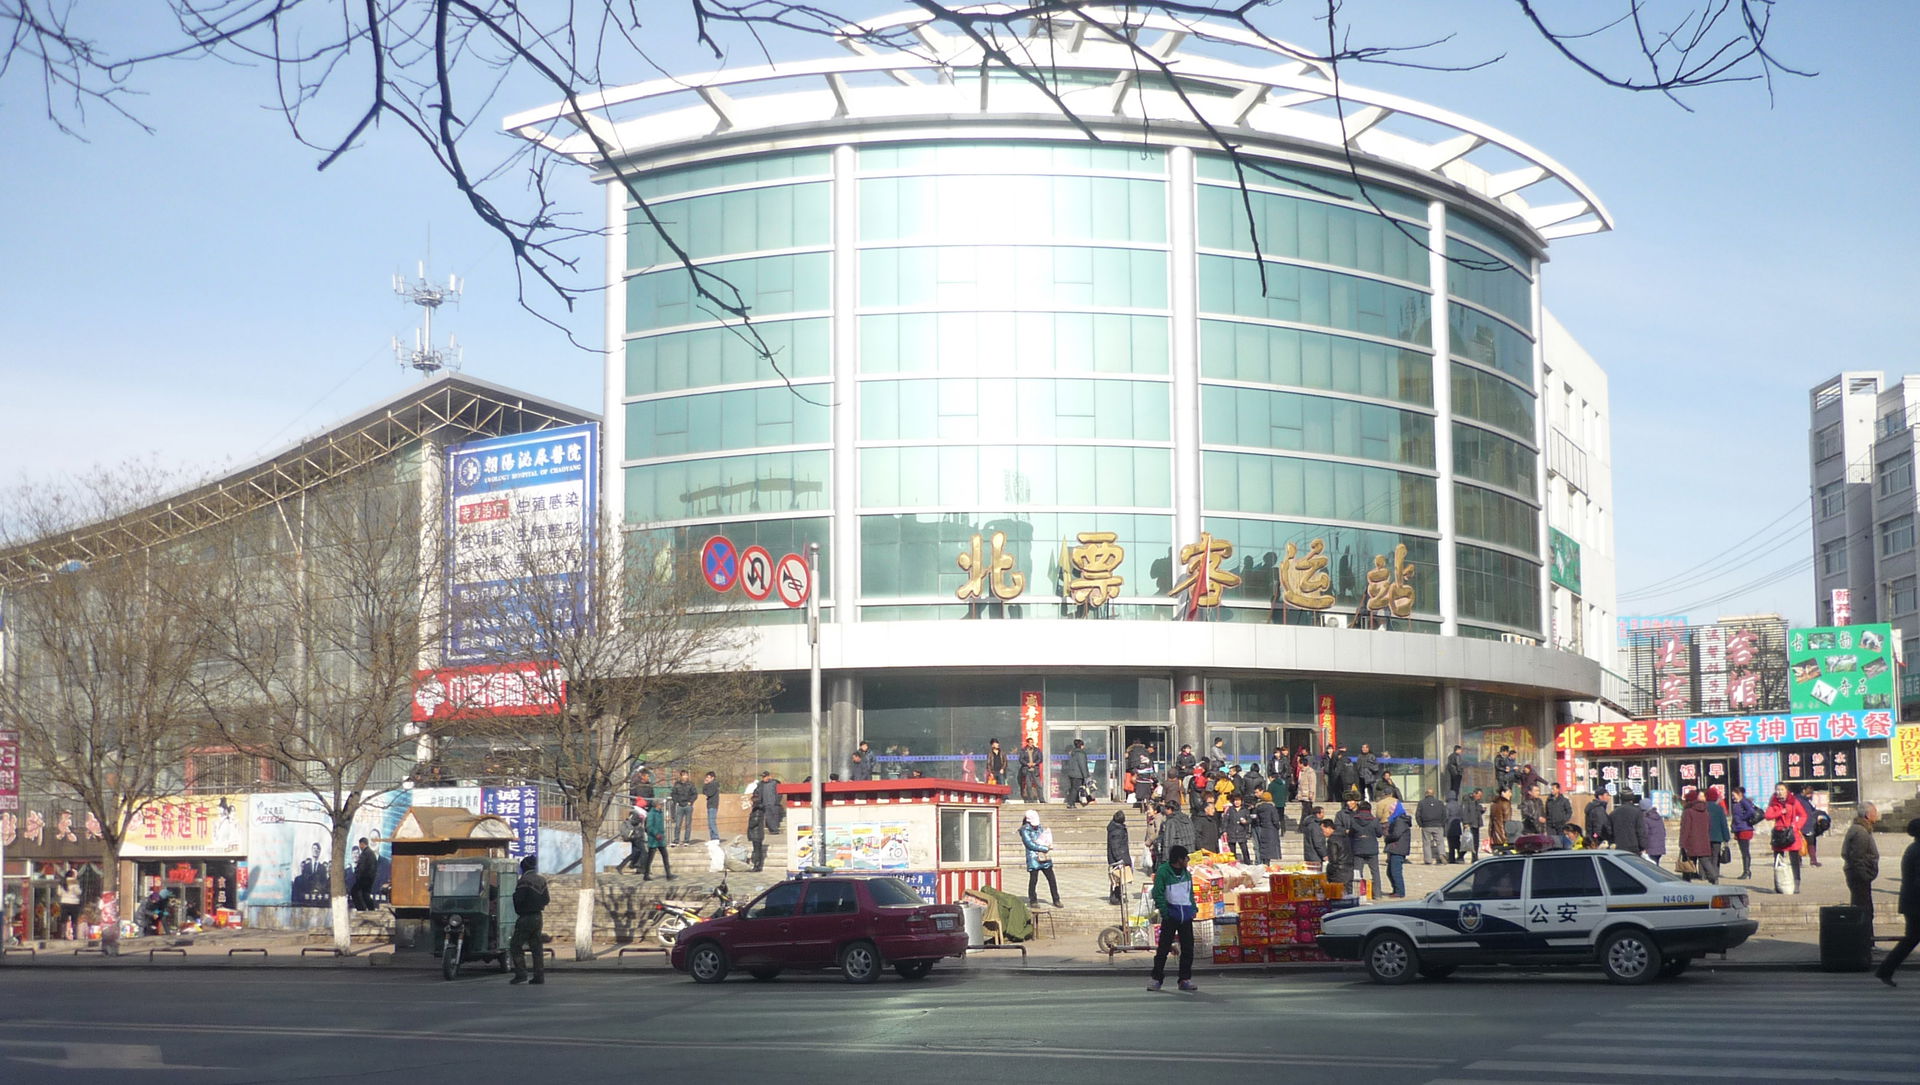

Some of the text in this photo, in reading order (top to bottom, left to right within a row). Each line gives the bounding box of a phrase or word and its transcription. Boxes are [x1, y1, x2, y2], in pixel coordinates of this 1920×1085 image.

[512, 470, 538, 479] HOSPITAL
[550, 464, 582, 475] CHAOYANG
[516, 491, 579, 514] 生殖感染
[955, 530, 1416, 617] 北票客运站
[1558, 722, 1681, 748] 北客宾馆
[1690, 712, 1892, 745] 北客抻面快餐
[523, 789, 536, 858] 大世界中介祝您
[1663, 894, 1695, 904] N4069
[1528, 903, 1578, 924] 公安
